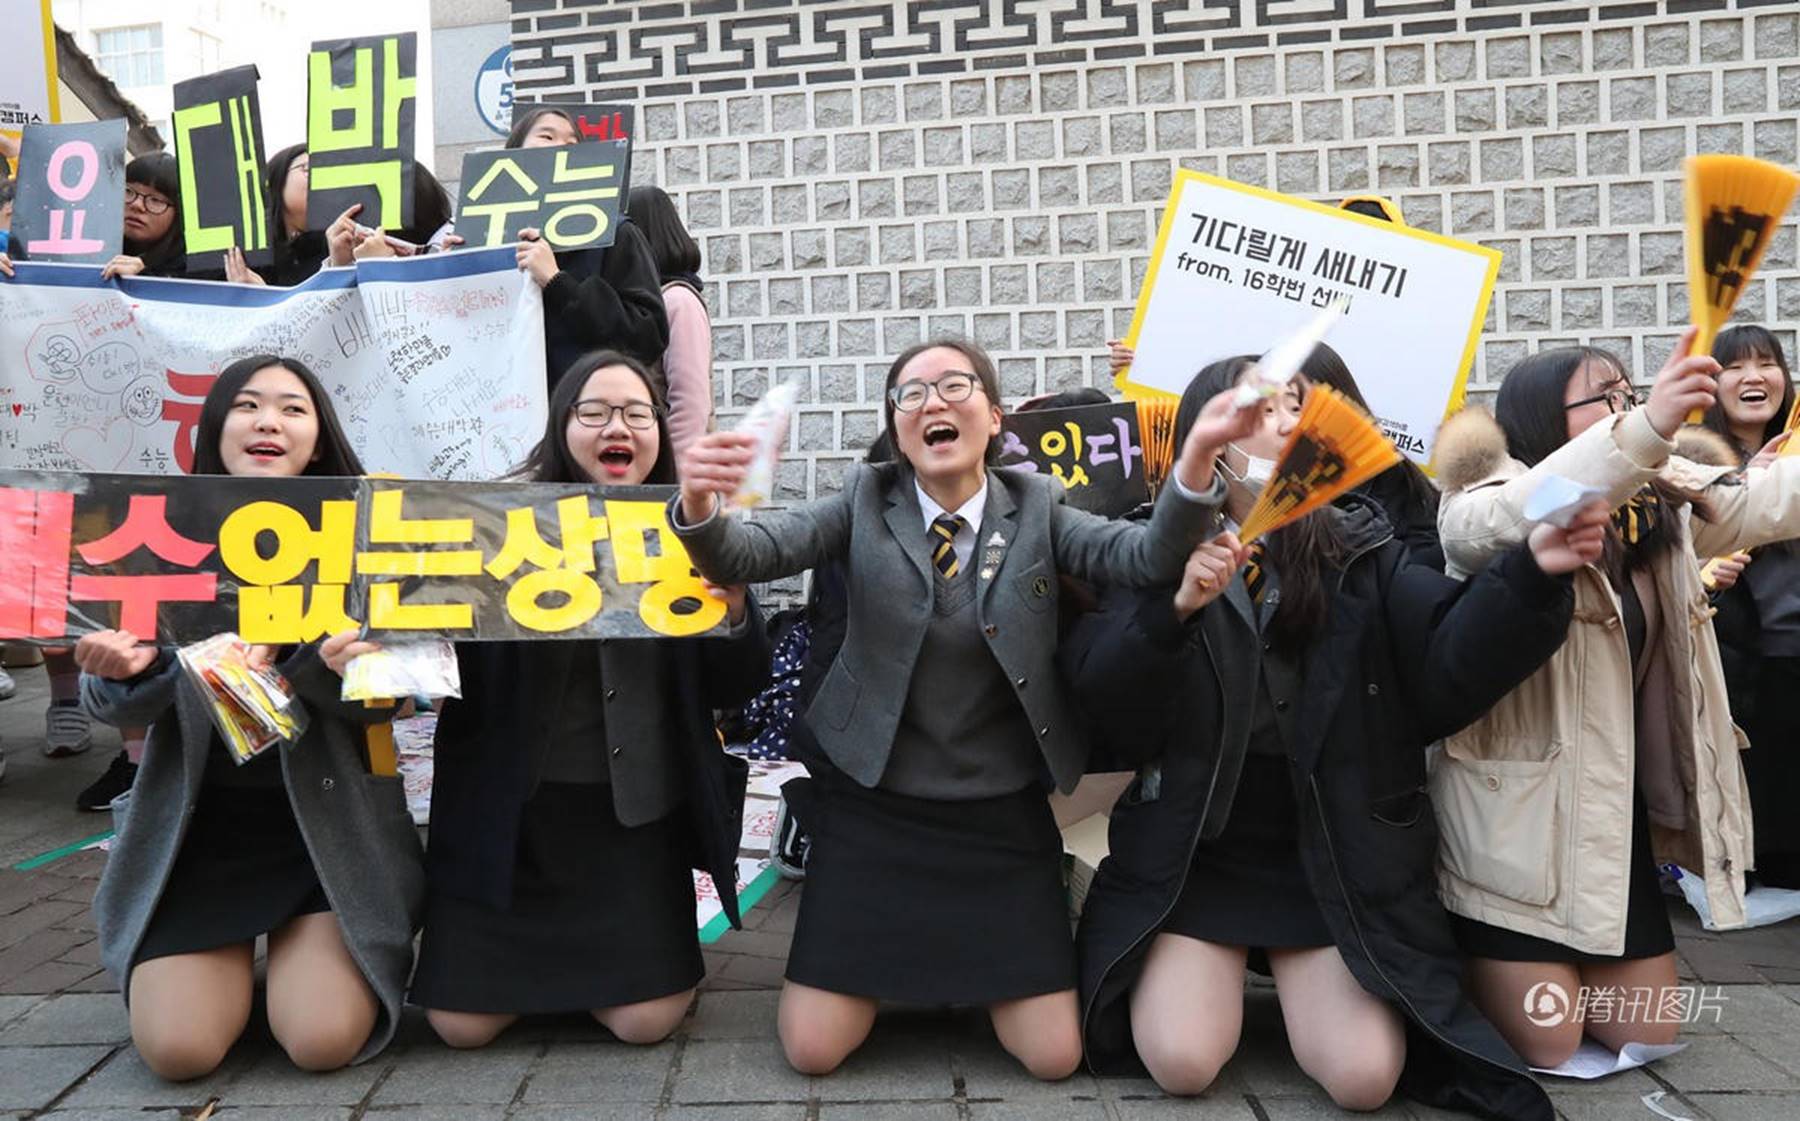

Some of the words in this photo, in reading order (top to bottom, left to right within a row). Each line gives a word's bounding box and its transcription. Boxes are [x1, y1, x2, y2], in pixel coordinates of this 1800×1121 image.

[174, 96, 267, 254] 대
[308, 38, 416, 231] 박
[28, 140, 104, 254] 요
[462, 151, 618, 247] 수능
[1190, 212, 1307, 271] 기다릴게
[1312, 248, 1407, 298] 새내기
[1241, 267, 1306, 302] 16학번
